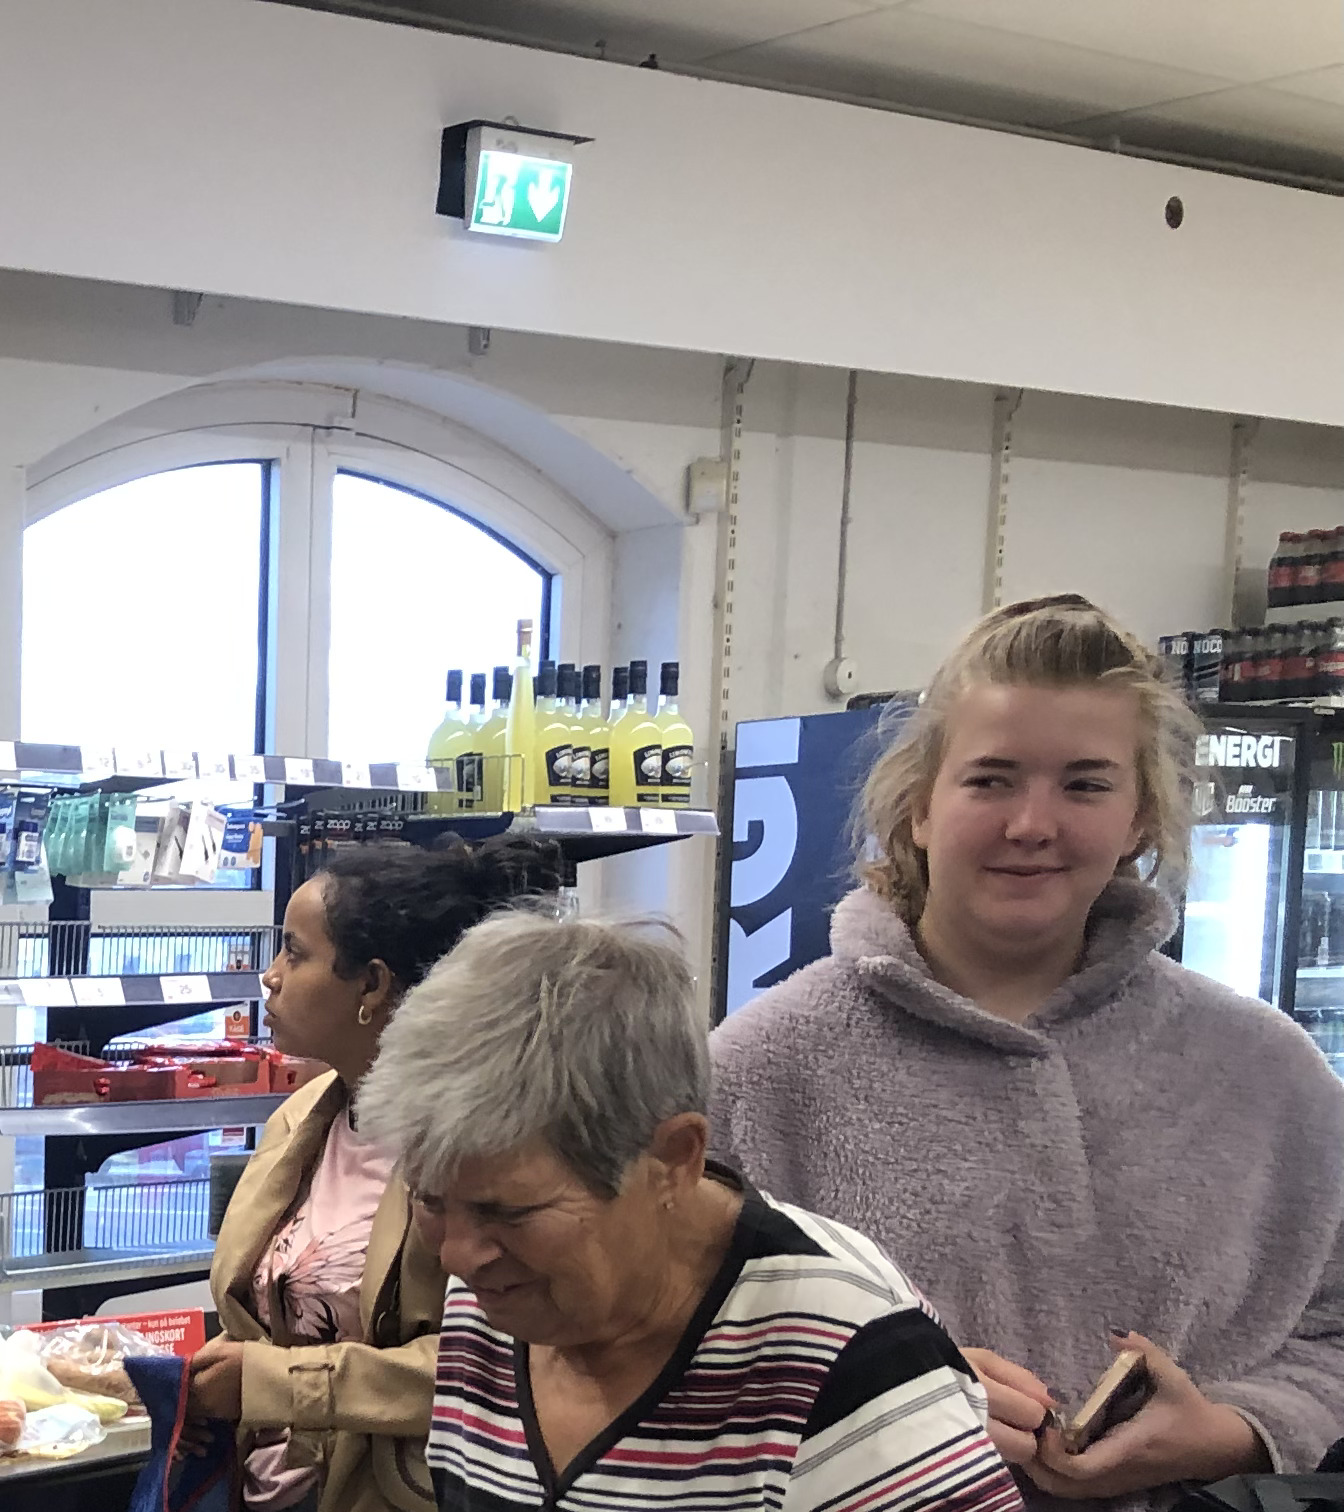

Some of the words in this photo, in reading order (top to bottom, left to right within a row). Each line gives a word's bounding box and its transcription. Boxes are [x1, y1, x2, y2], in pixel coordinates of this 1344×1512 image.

[1195, 734, 1280, 767] ENERGI
[1225, 795, 1278, 814] Booster
[144, 1328, 186, 1344] INGSKORT
